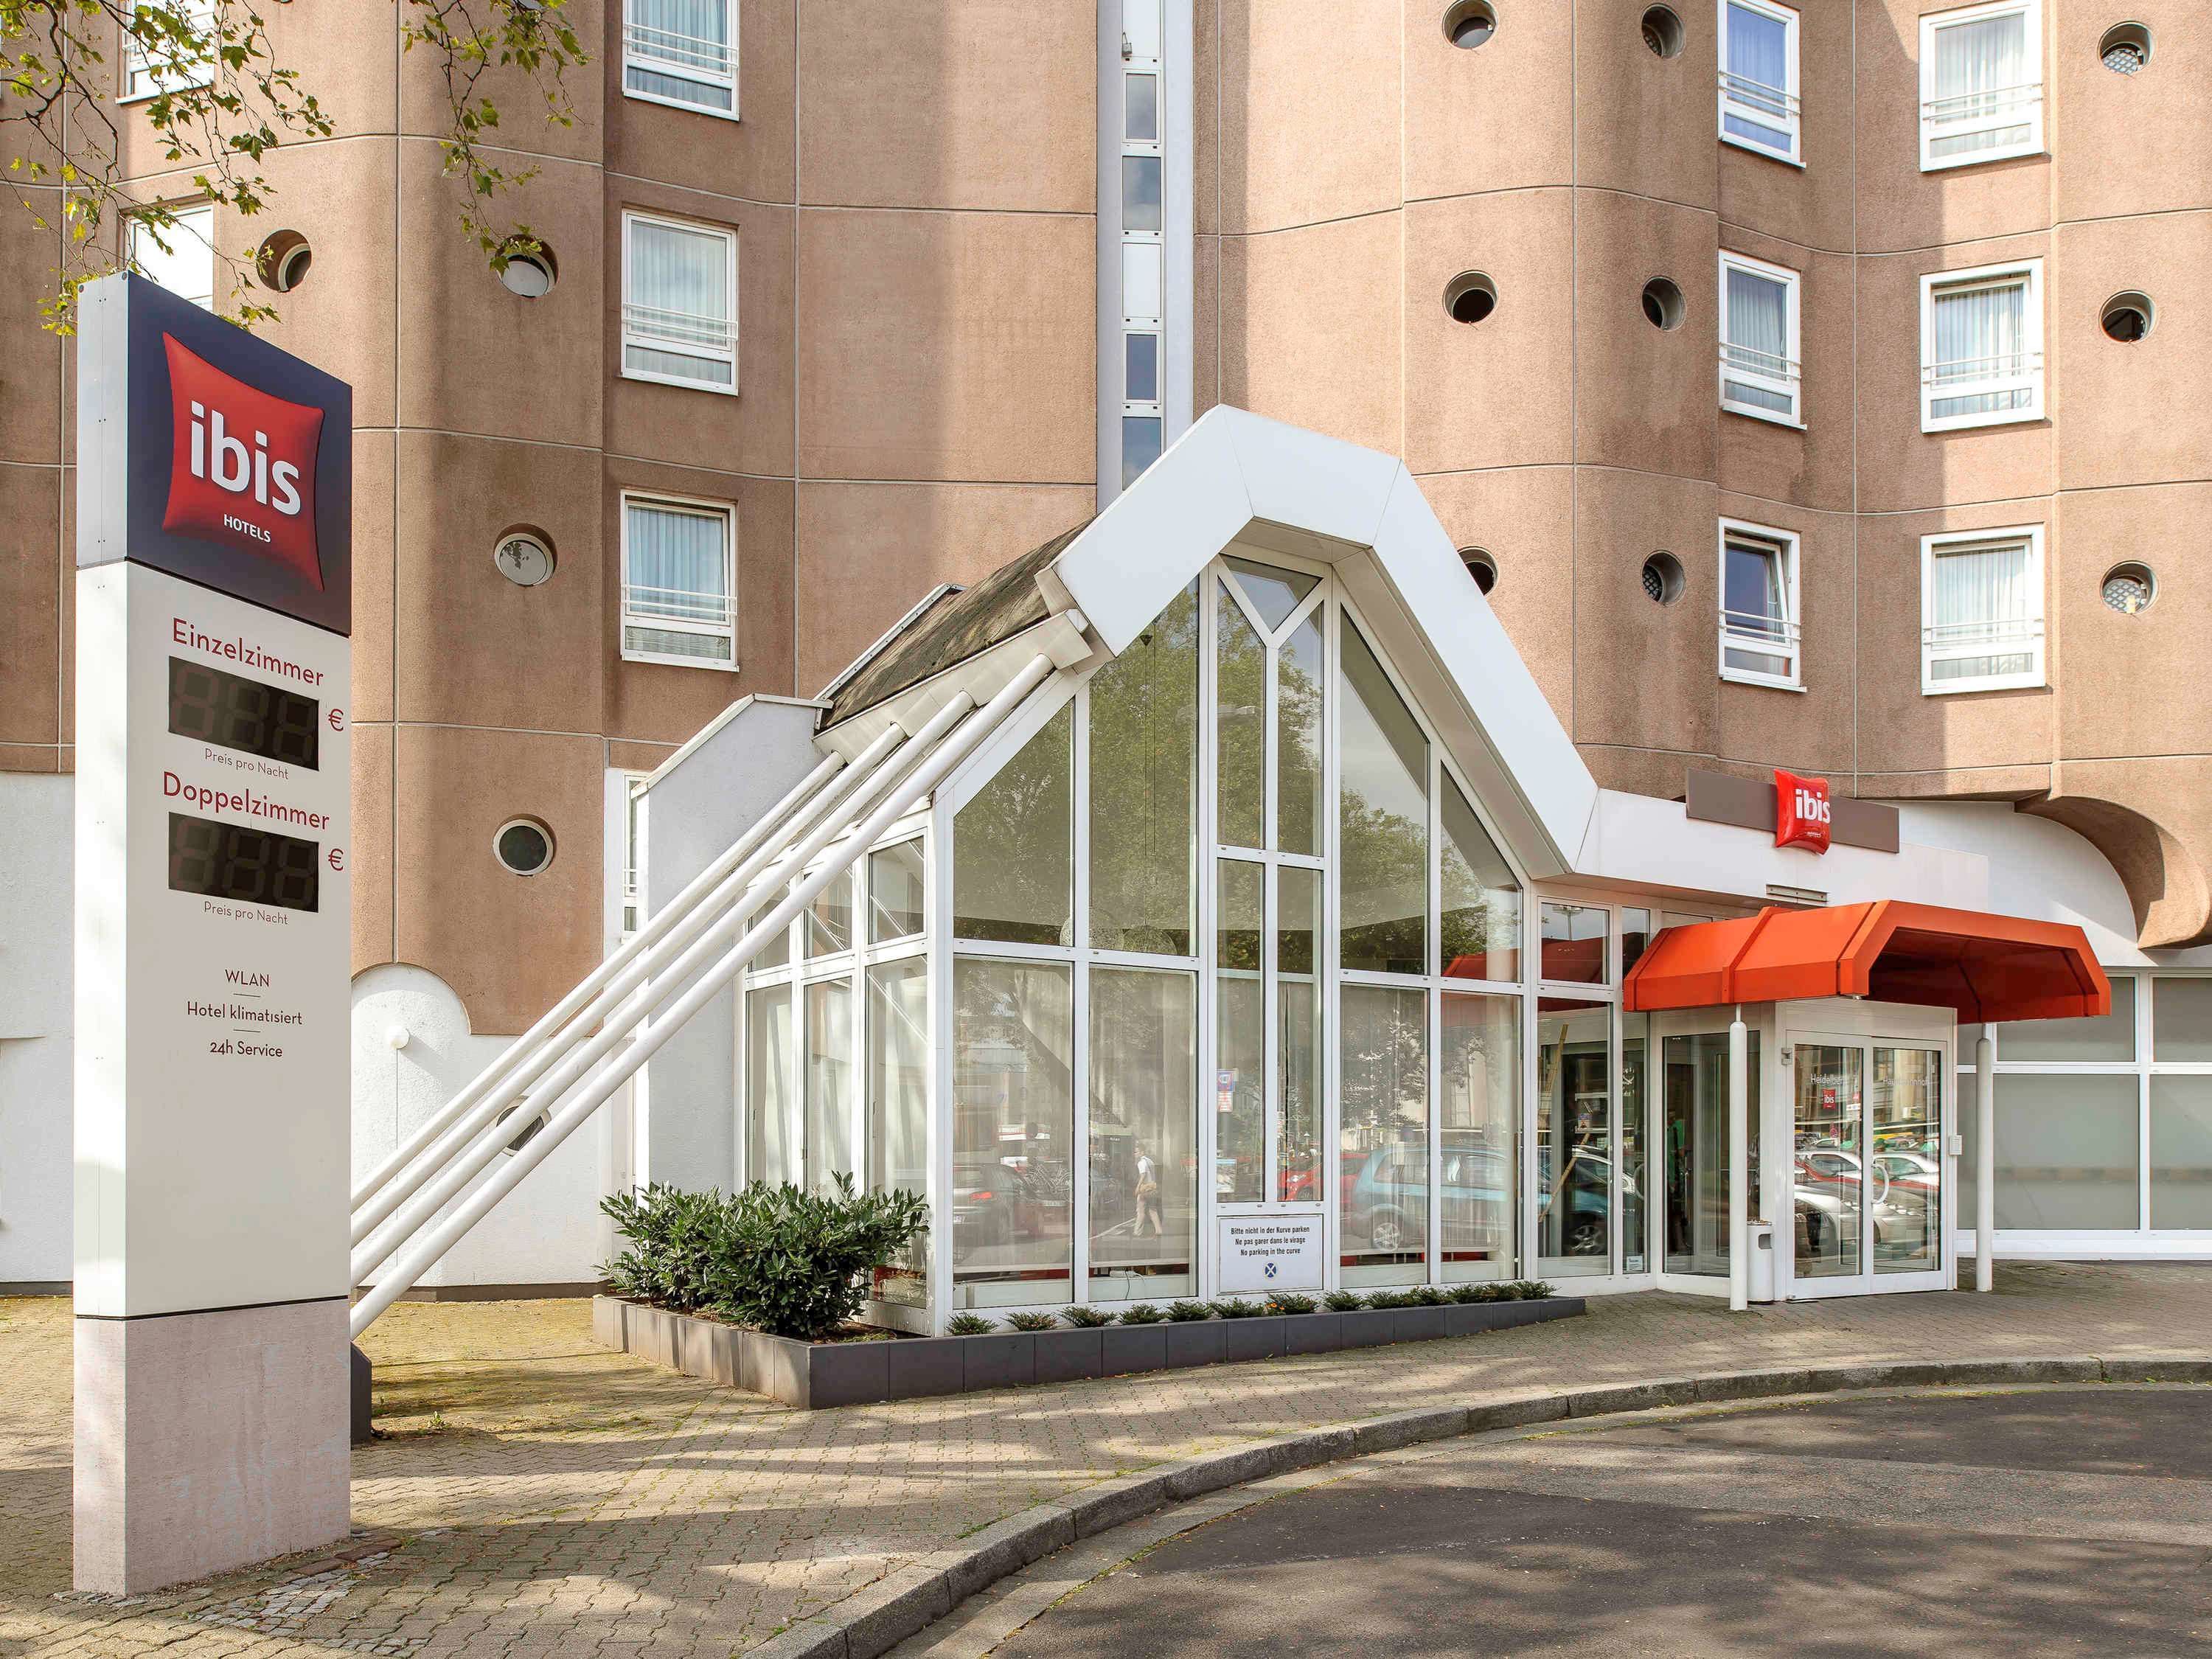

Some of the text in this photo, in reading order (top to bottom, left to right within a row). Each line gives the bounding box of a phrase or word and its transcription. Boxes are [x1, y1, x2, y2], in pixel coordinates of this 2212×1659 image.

[191, 400, 301, 515] ibis
[223, 514, 271, 543] HOTELS
[173, 617, 324, 686] Einzelzimmer
[327, 708, 344, 732] €
[205, 748, 289, 780] Preis pro Nacht
[164, 771, 330, 830] Doppelzimmer
[1795, 788, 1832, 824] ibis
[327, 848, 344, 872] €
[204, 901, 288, 925] Preis pro Nacht
[225, 969, 270, 987] WLAN
[187, 1001, 226, 1018] Hotel
[209, 1039, 283, 1057] 24h Service
[1810, 1073, 1846, 1085] Heidelber
[1823, 1093, 1834, 1103] ibis
[1248, 1248, 1268, 1256] parking
[1290, 1237, 1306, 1245] virage
